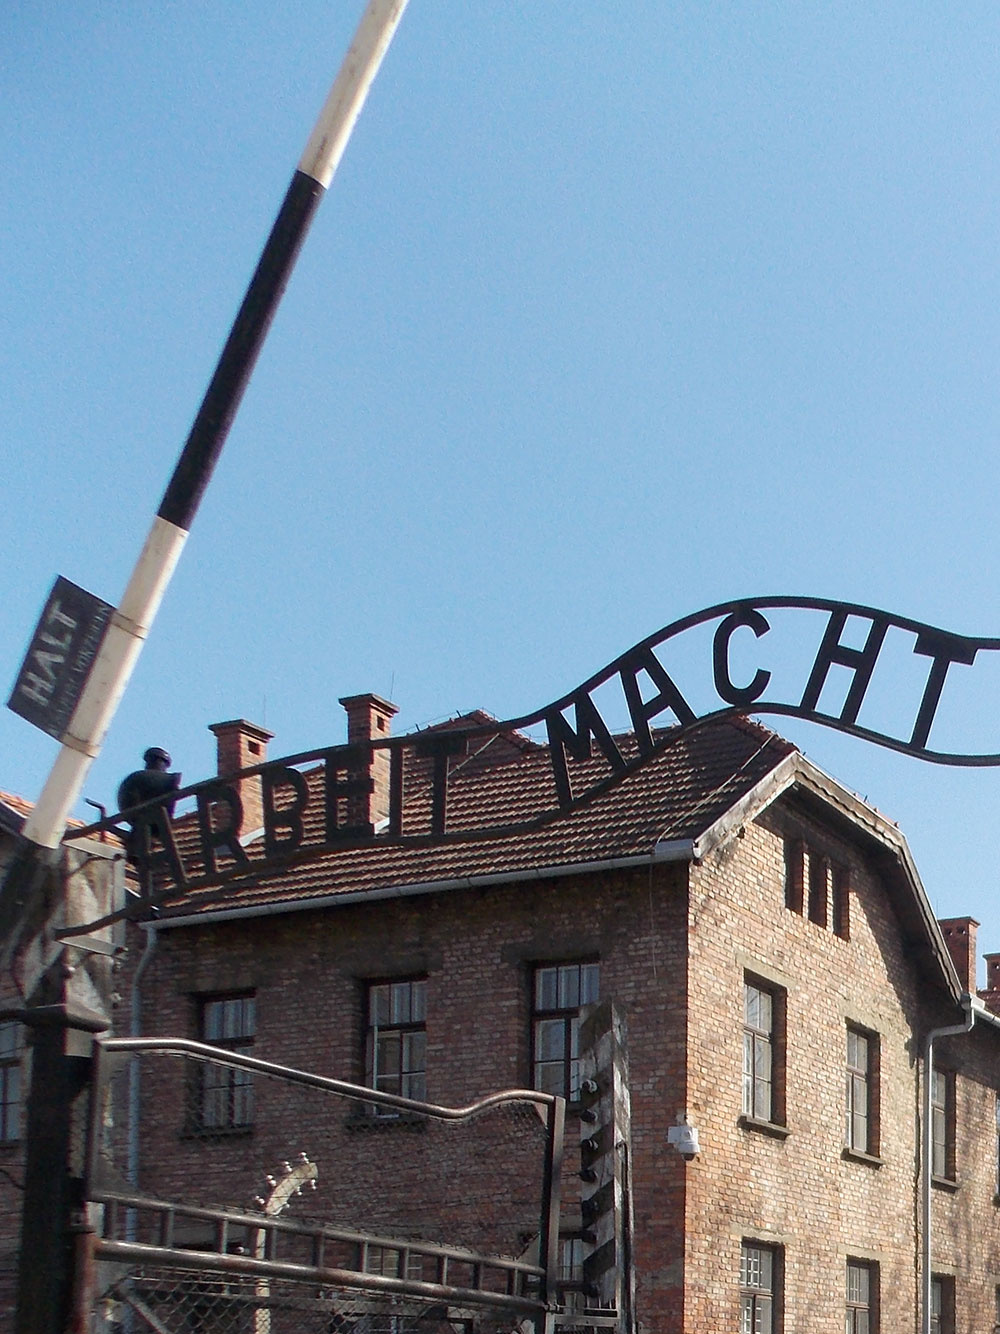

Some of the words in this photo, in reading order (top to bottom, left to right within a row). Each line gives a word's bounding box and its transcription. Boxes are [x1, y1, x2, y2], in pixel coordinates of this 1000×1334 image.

[19, 601, 78, 706] HALT
[137, 735, 469, 903] ARBEIT
[545, 604, 979, 801] MACHT
